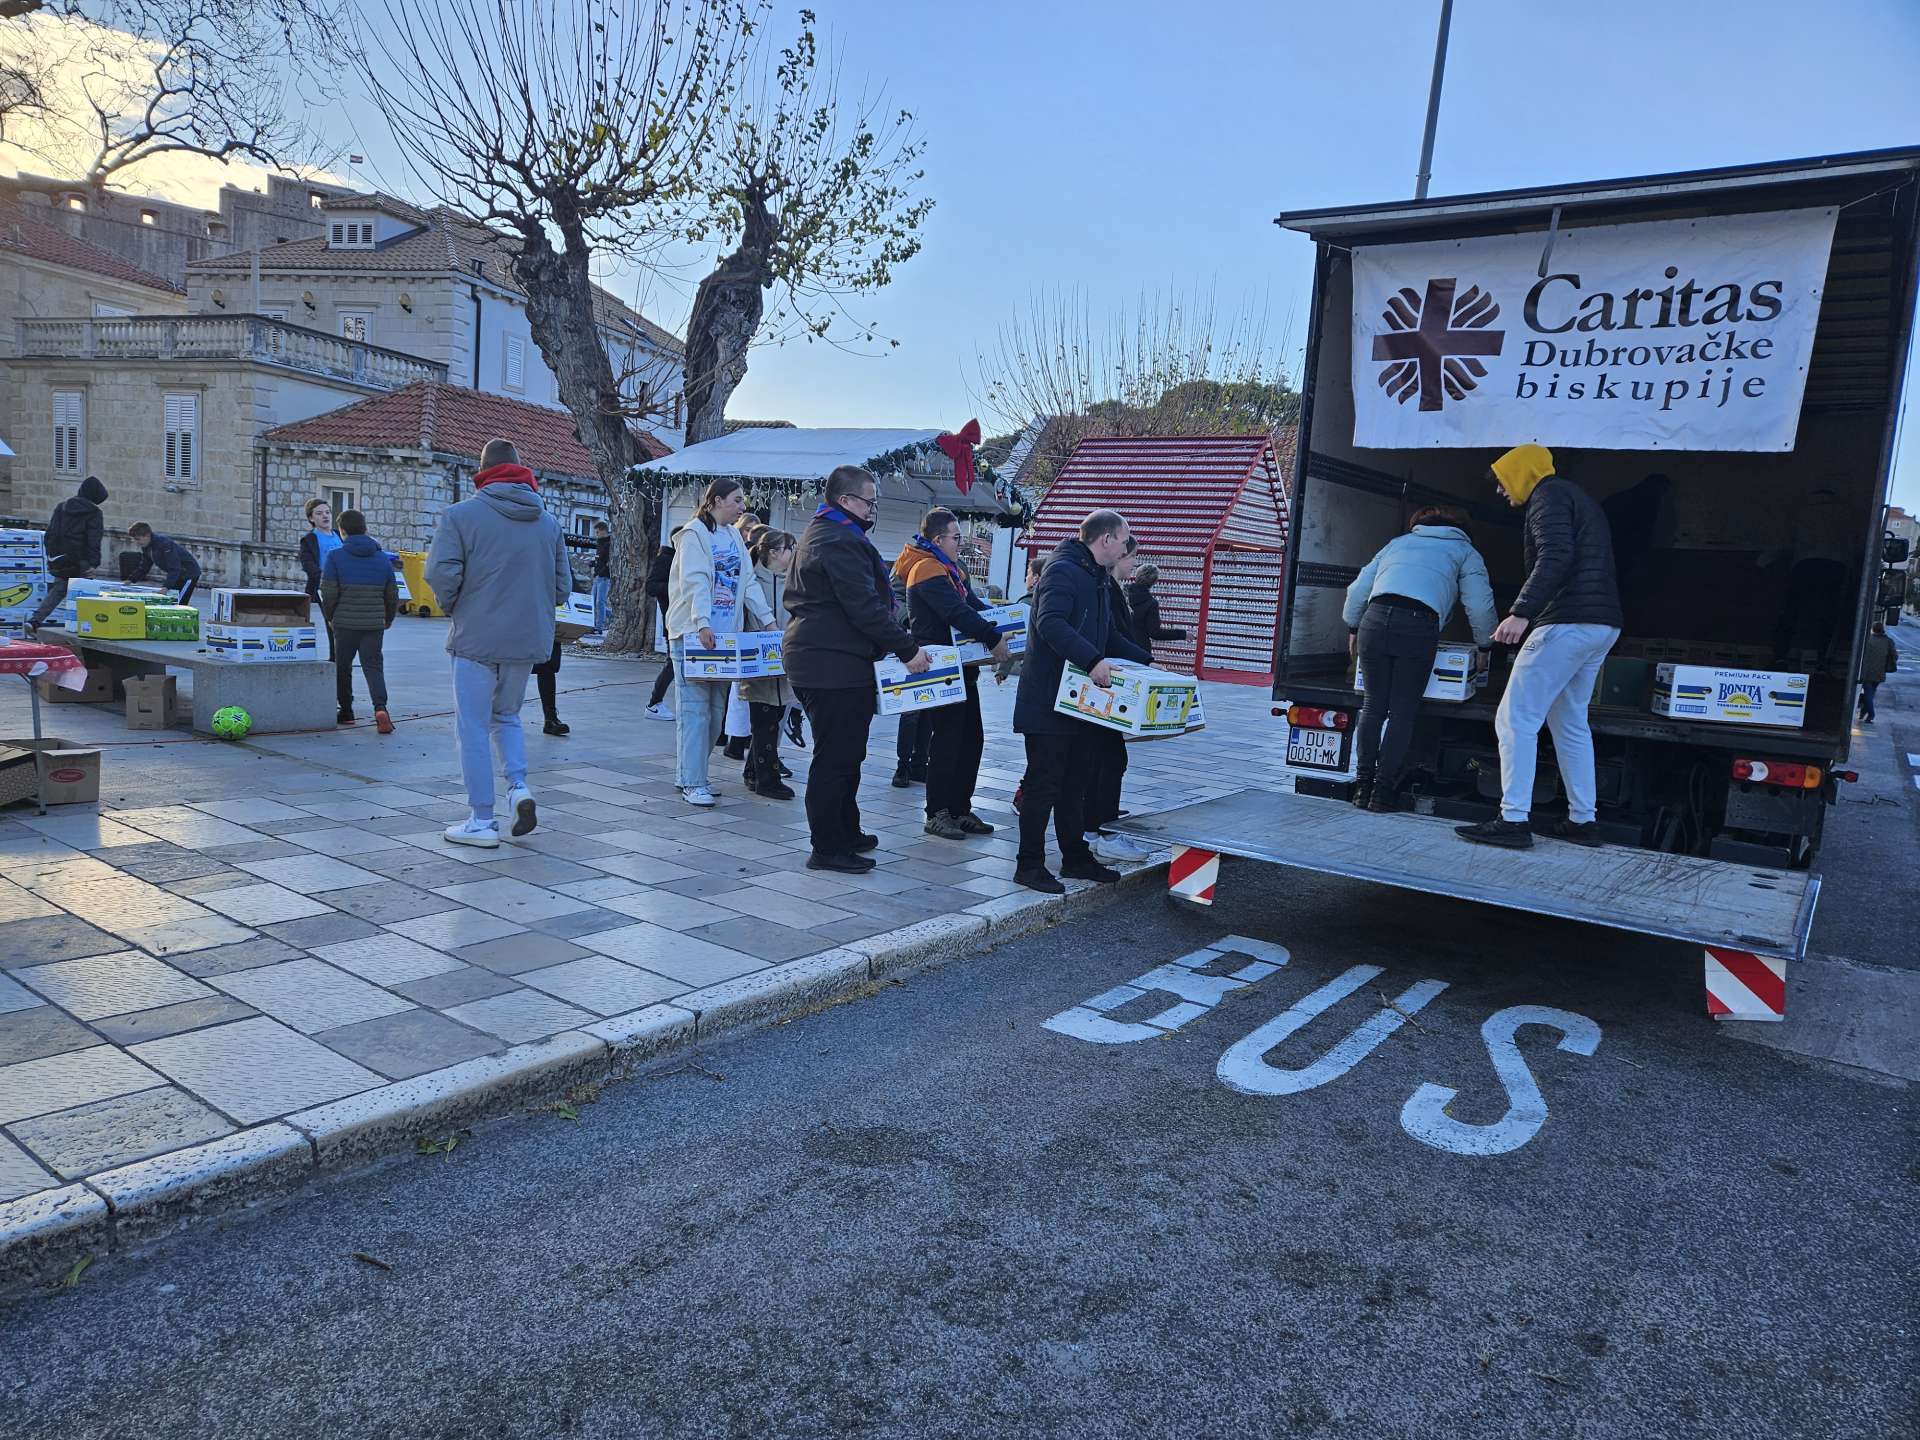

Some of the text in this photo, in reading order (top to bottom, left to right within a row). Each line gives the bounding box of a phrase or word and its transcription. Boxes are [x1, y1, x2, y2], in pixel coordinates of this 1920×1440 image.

[1523, 266, 1784, 334] Caritas
[1520, 330, 1774, 368] Dubrovačke
[1516, 367, 1766, 411] biskupije
[1714, 670, 1772, 681] PREMIUM PACK
[1718, 682, 1763, 703] BONITA
[1306, 731, 1325, 747] DU
[1290, 746, 1337, 765] 0031-MK
[1040, 934, 1602, 1156] BUS
